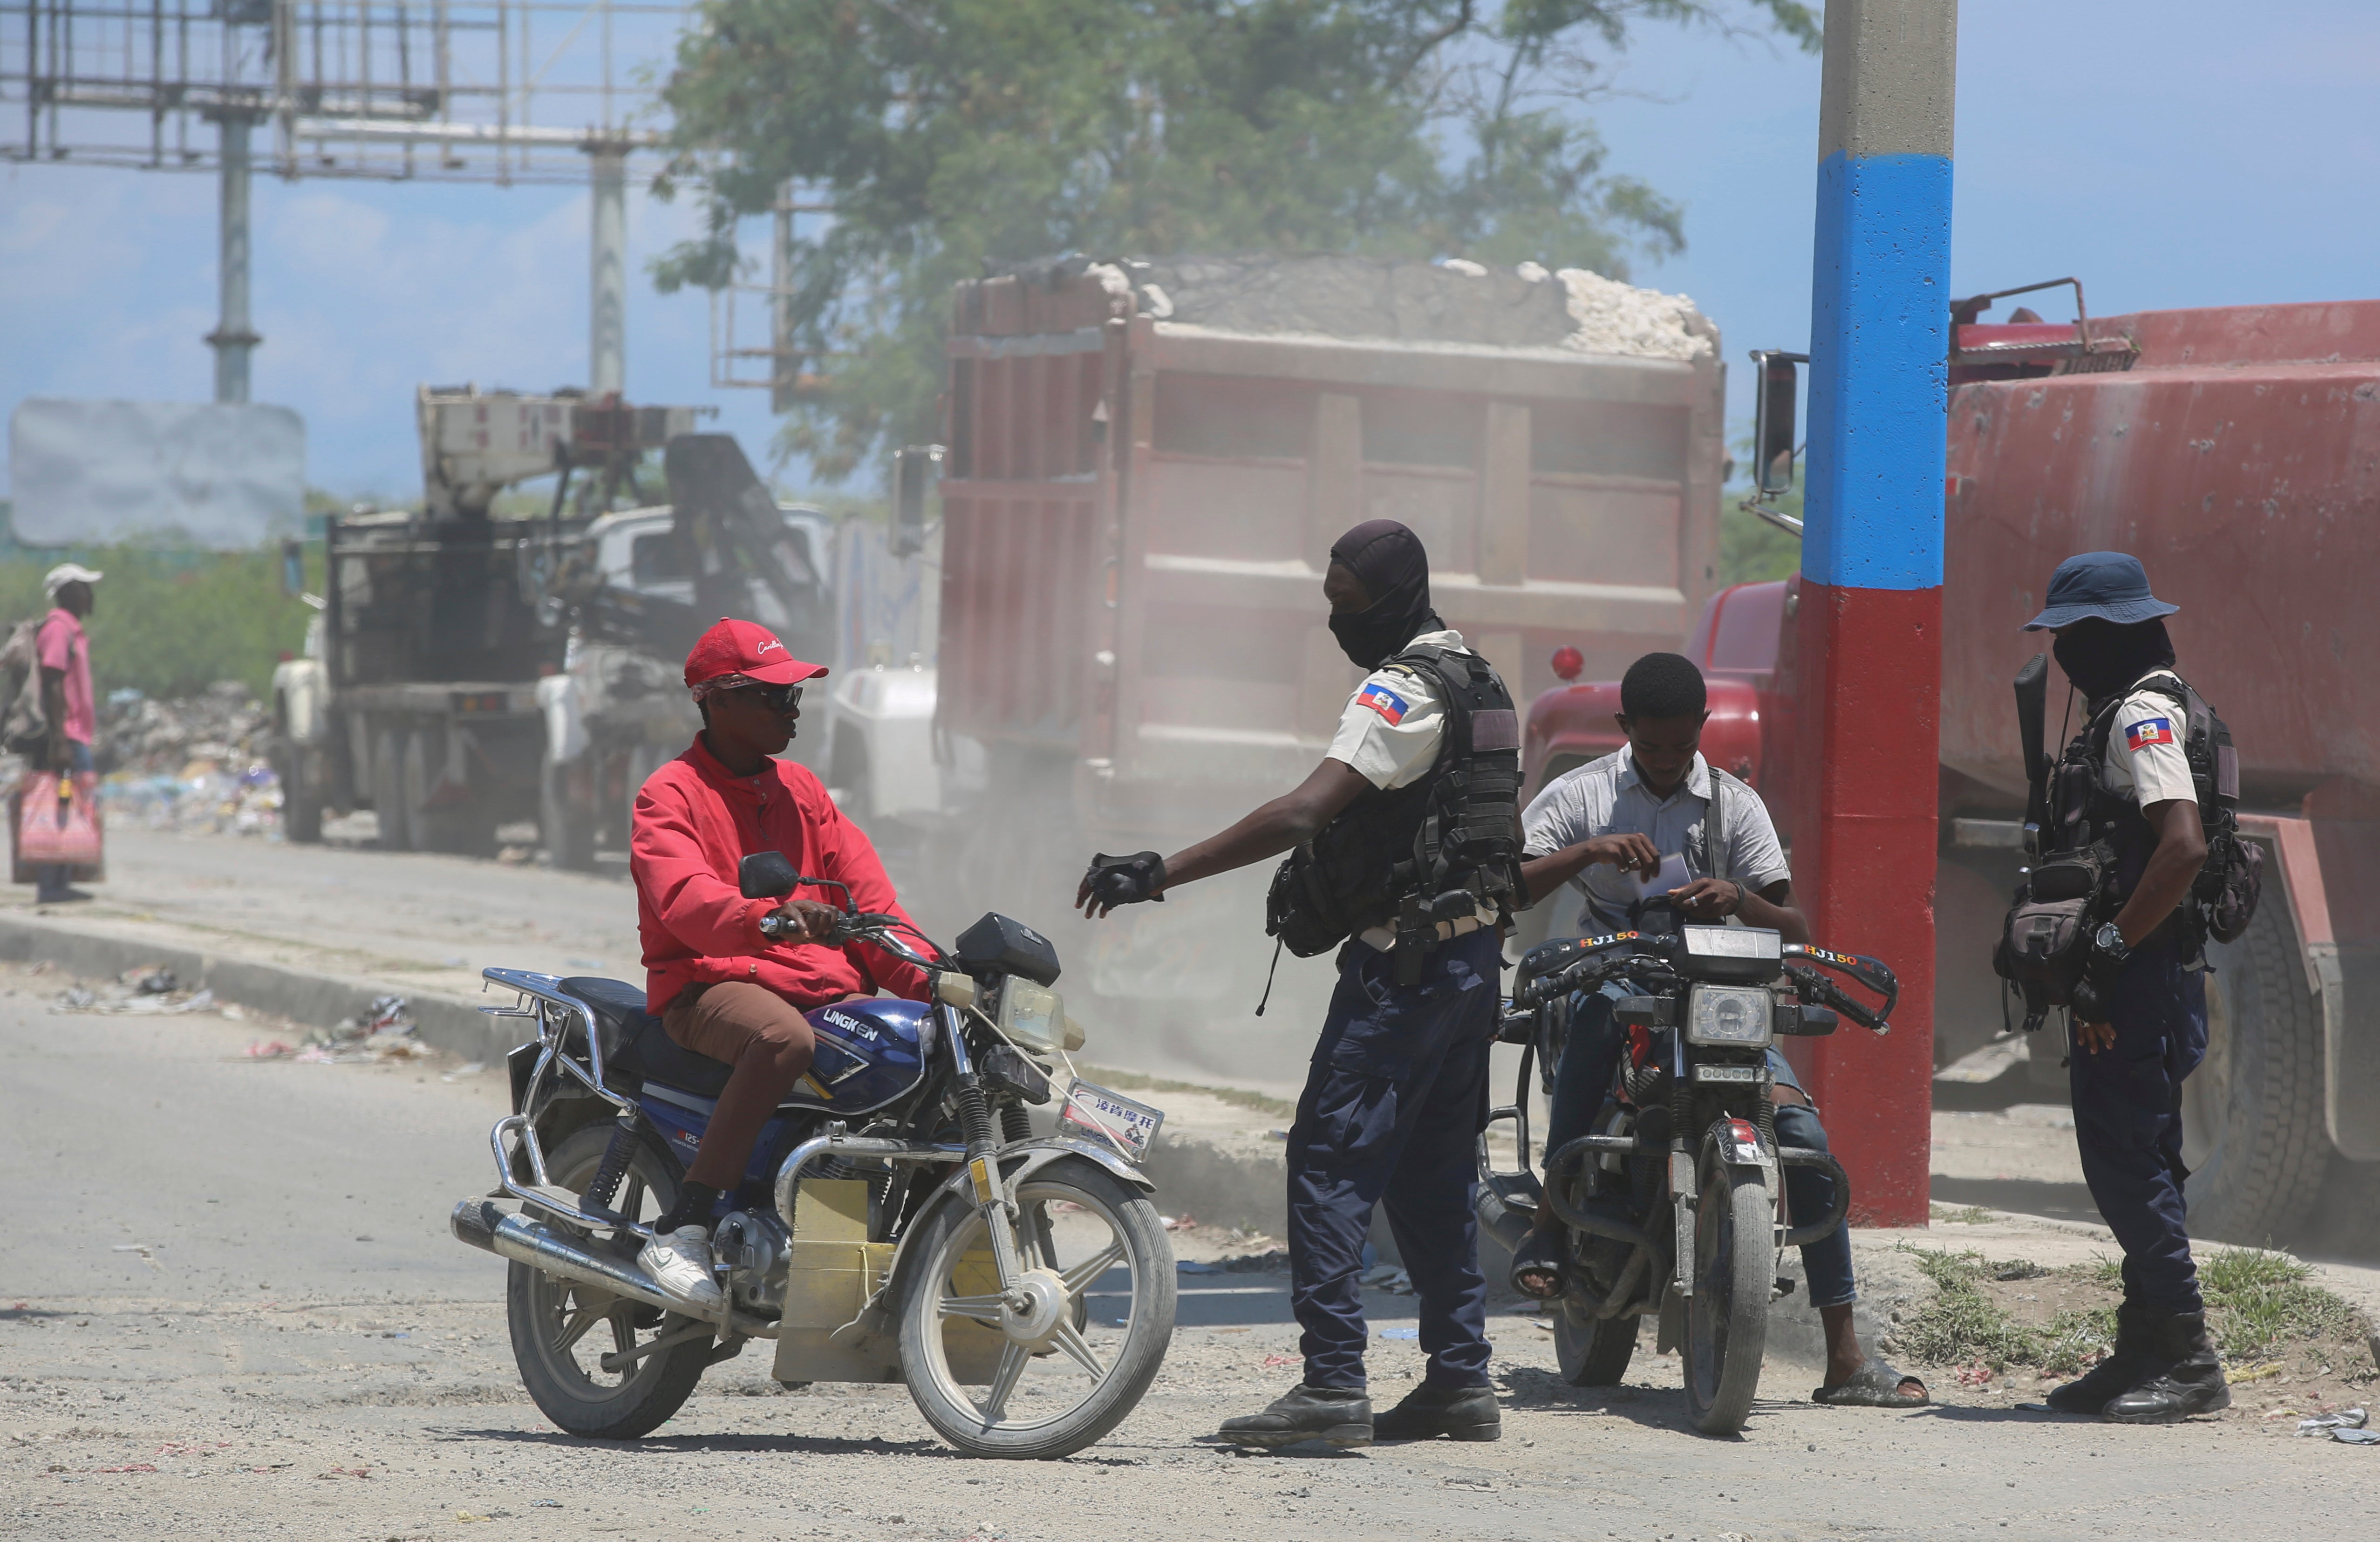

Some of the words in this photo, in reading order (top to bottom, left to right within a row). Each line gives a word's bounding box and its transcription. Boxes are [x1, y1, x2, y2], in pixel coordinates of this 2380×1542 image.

[1579, 930, 1639, 948] HJ150
[1803, 944, 1857, 966] HJ150
[822, 1008, 879, 1042] LINGKEN
[1095, 1098, 1154, 1130] 凌肯摩托
[1080, 1127, 1115, 1148] LINGKE
